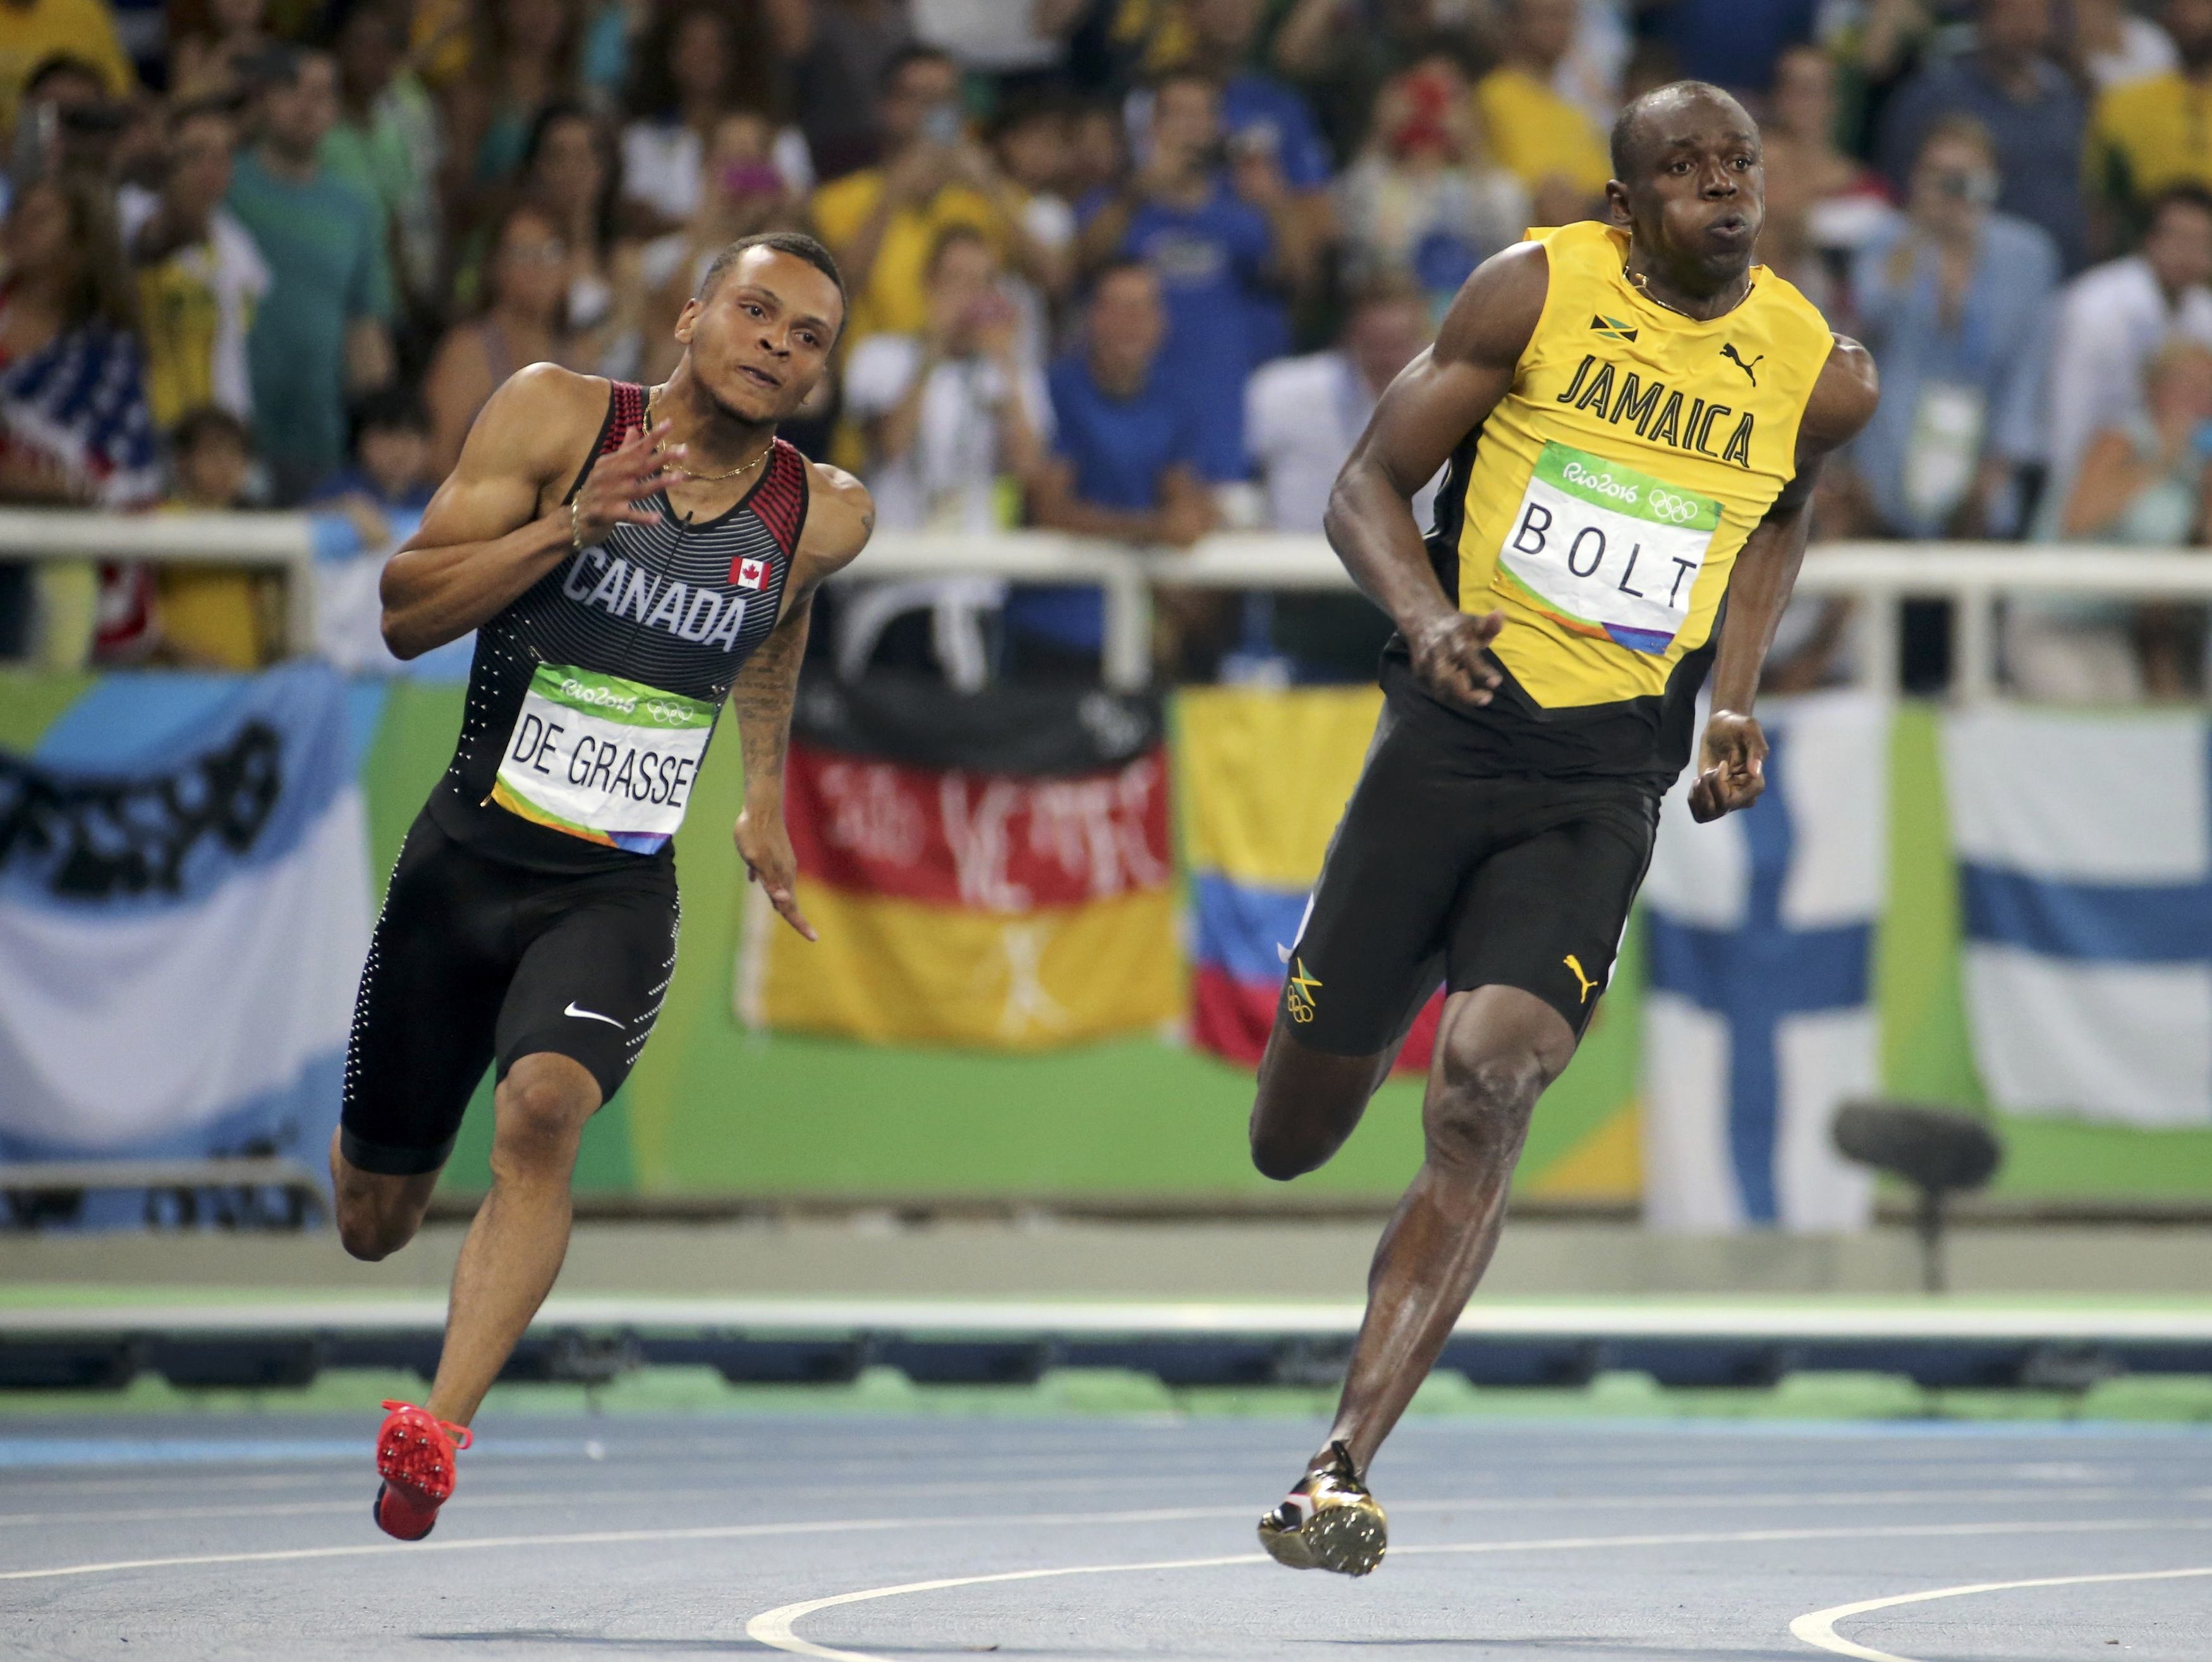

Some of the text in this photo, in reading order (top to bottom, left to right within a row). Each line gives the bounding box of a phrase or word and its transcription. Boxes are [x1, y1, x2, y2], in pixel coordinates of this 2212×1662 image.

[1557, 354, 1754, 469] JAMAICA
[563, 546, 747, 652] CANADA
[1512, 502, 1698, 608] BOLT
[511, 713, 695, 808] DE GRASSE
